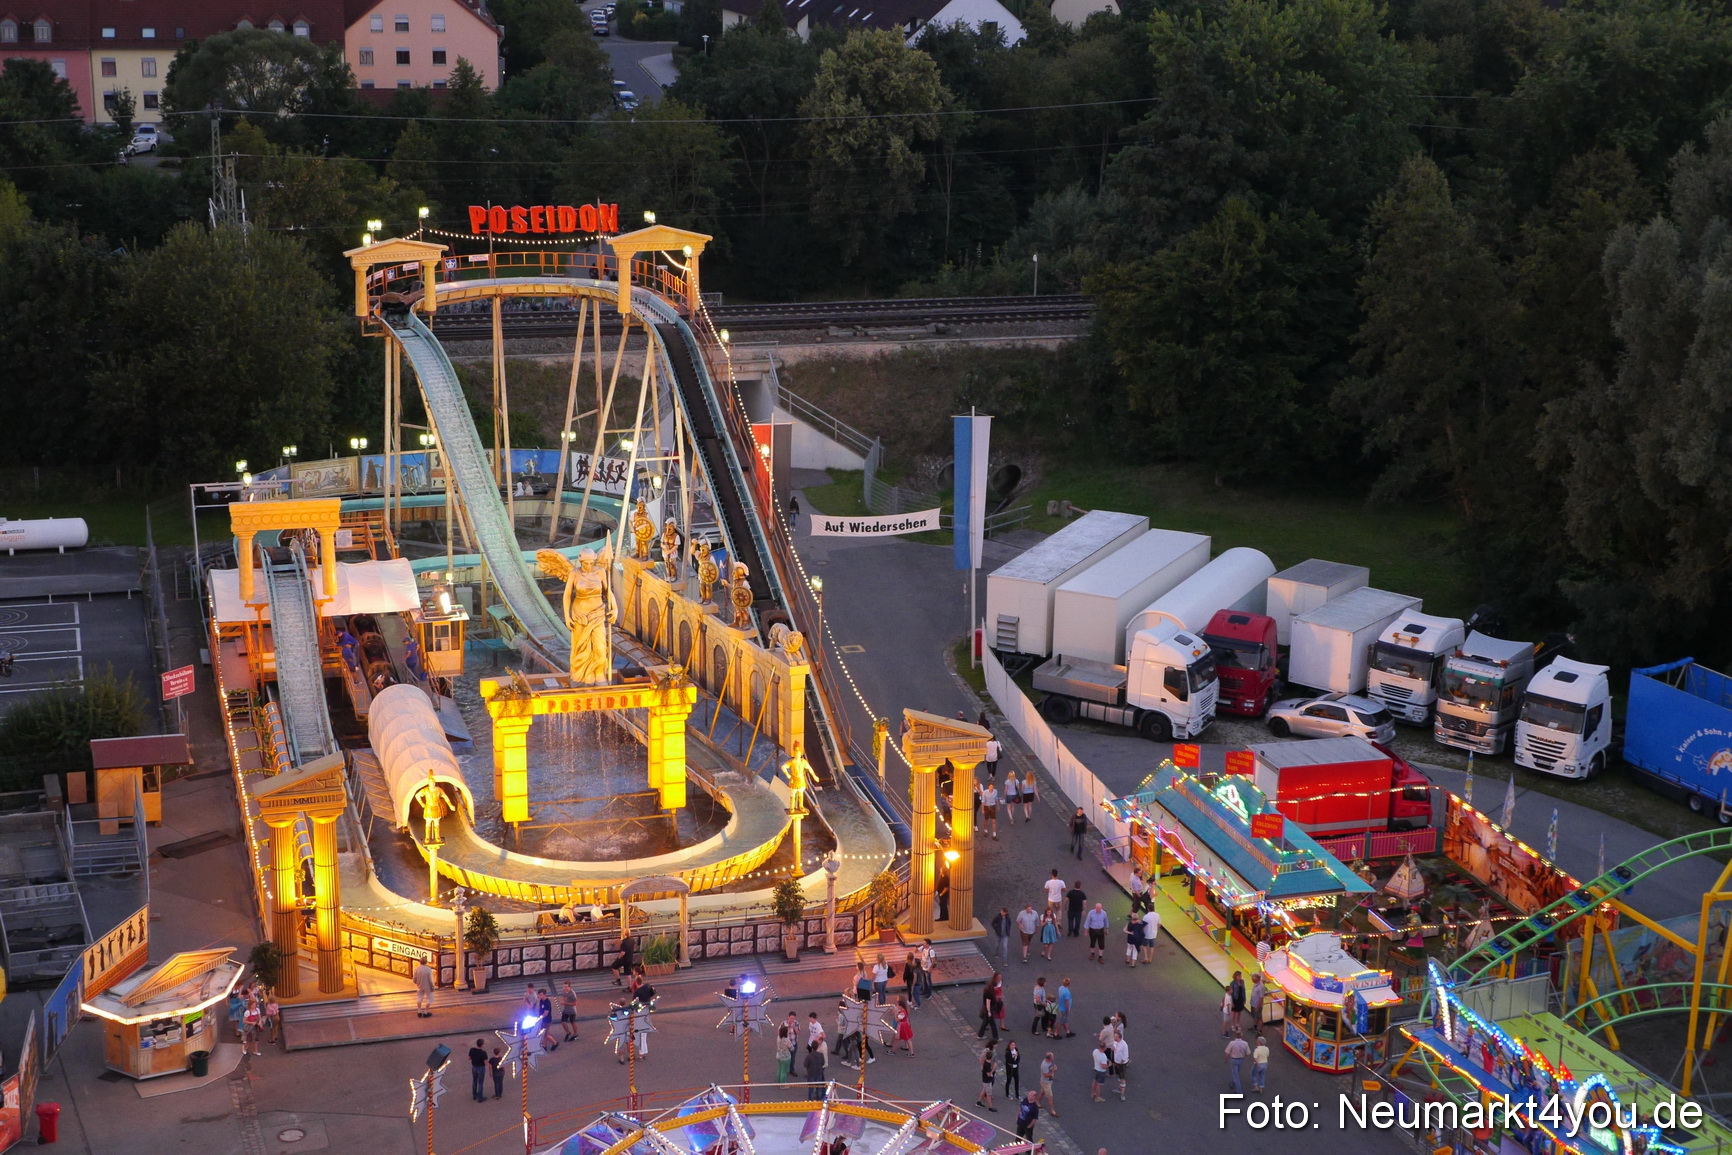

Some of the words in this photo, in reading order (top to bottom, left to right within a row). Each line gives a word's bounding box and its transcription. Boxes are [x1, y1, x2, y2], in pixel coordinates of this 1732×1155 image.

[468, 203, 619, 234] POSEIDON
[824, 521, 845, 532] Auf
[849, 519, 927, 533] Wiedersehen
[548, 694, 642, 712] POSEIDON
[1679, 733, 1696, 753] Kaiser
[1704, 728, 1722, 736] Sohn
[392, 944, 427, 960] EINGANG
